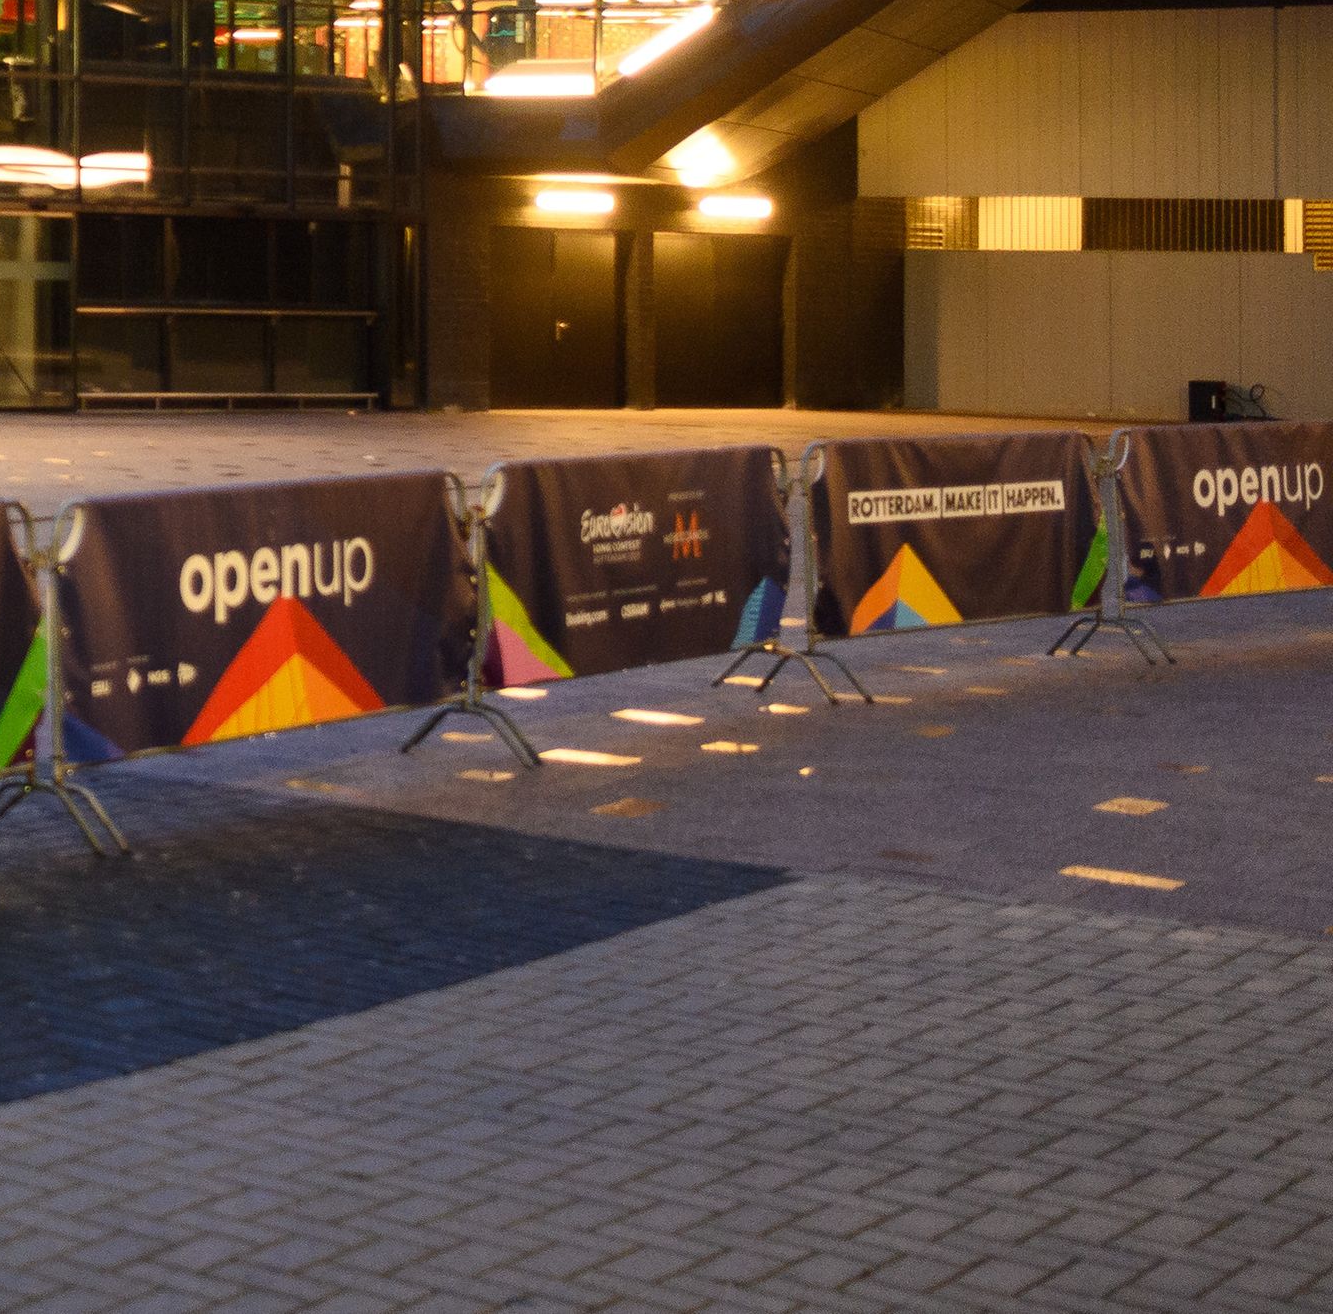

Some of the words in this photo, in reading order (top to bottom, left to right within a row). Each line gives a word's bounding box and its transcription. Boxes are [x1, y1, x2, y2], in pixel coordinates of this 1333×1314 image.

[851, 496, 939, 518] ROTTERDAM.
[945, 492, 982, 511] MAKE
[987, 490, 1000, 509] IT
[1006, 486, 1061, 508] HAPPEN.
[1193, 462, 1324, 517] openup
[179, 536, 374, 624] openup
